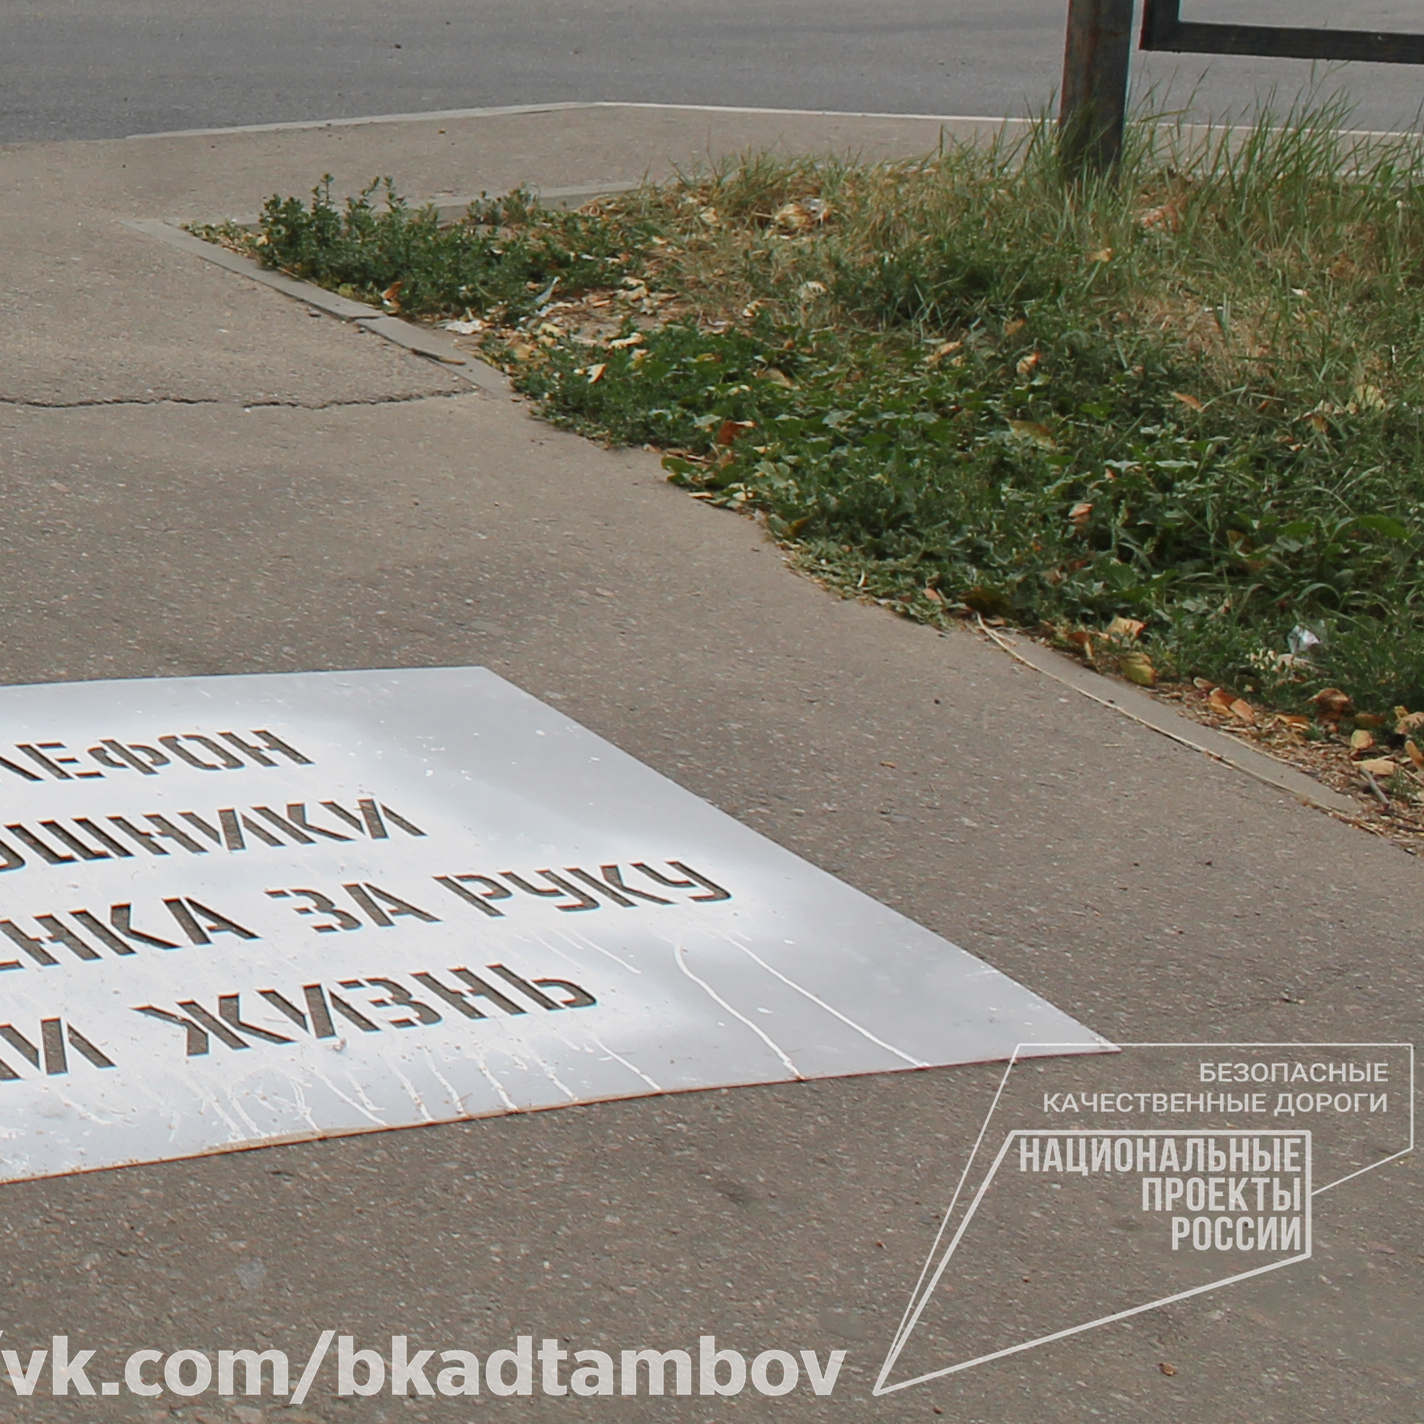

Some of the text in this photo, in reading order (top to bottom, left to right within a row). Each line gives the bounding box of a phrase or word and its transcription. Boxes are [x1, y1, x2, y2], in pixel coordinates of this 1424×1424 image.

[264, 884, 442, 933] ЗА
[433, 861, 732, 917] РУКУ
[132, 964, 597, 1058] ЖИЗНЬ
